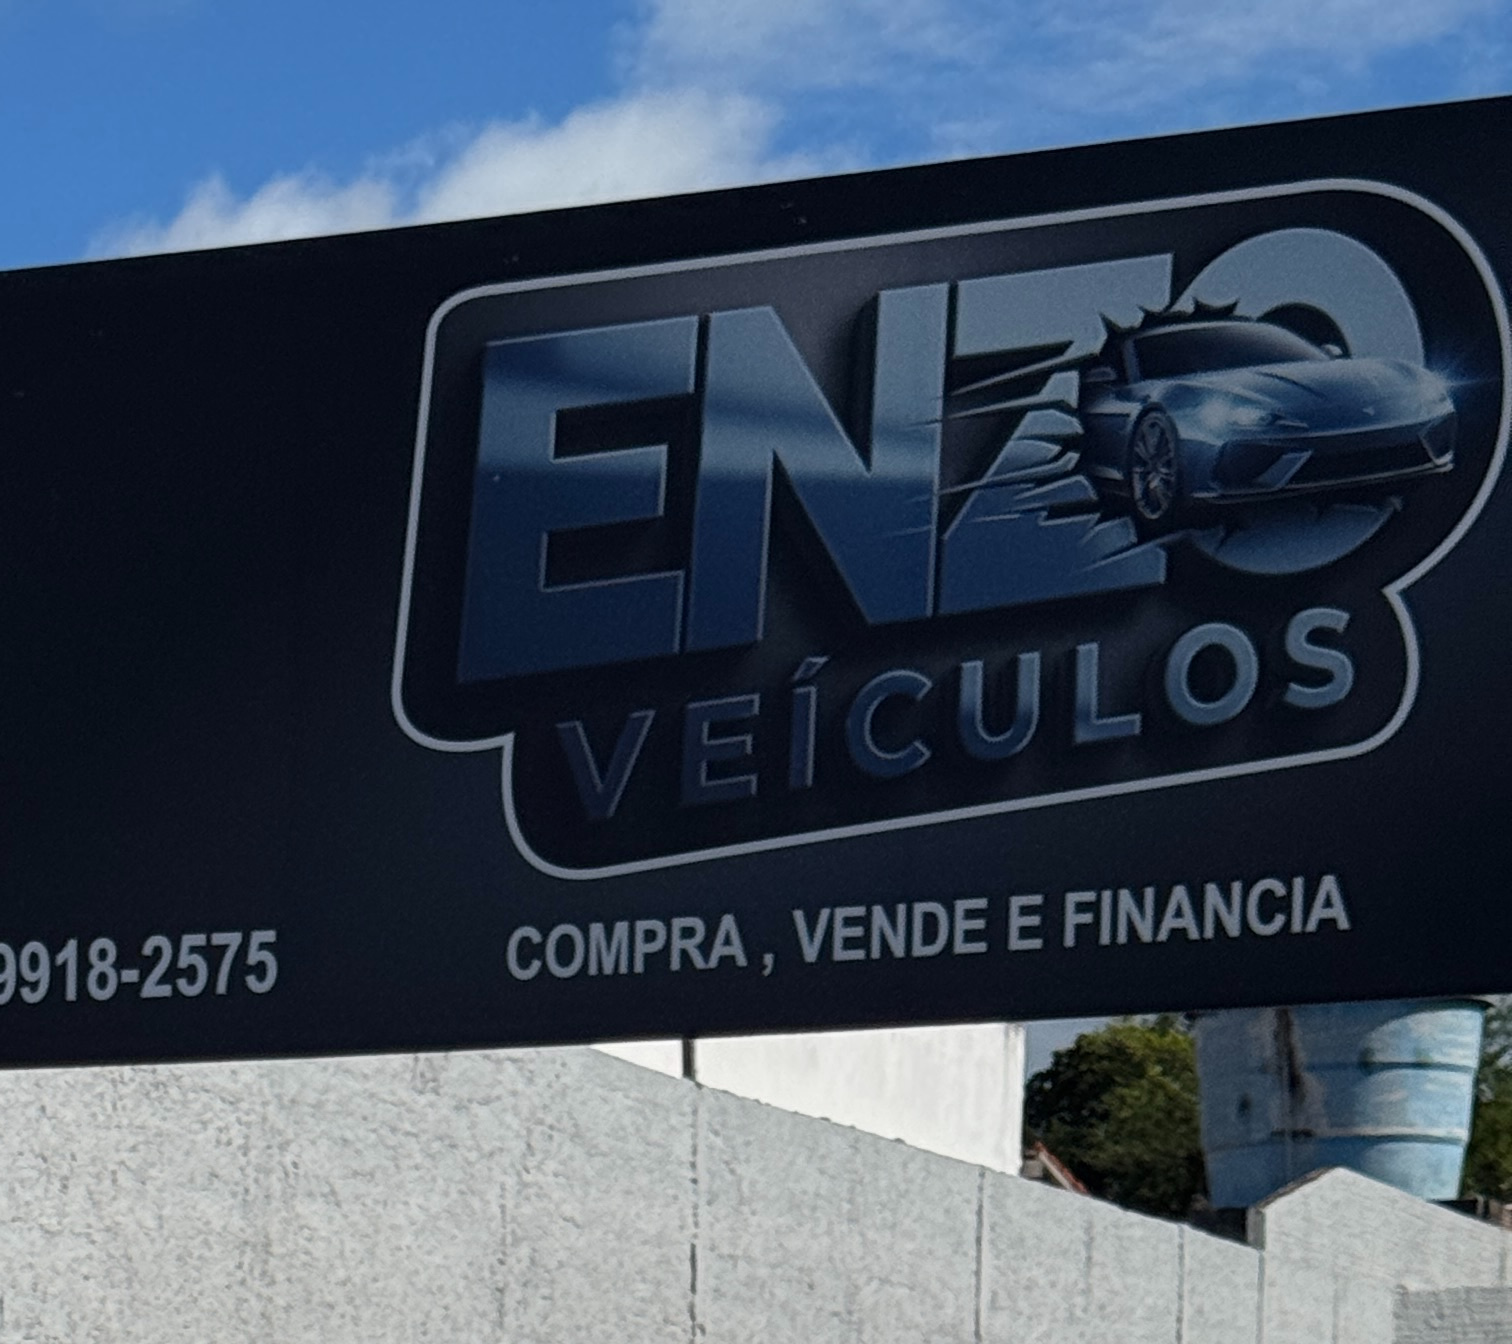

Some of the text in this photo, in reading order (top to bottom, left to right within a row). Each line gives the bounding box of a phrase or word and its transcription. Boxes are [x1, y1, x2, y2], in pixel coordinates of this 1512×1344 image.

[456, 226, 1424, 686] ENZO
[555, 607, 1356, 822] VEÍCULOS
[792, 896, 989, 964] VENDE
[1007, 893, 1044, 952] E
[1062, 875, 1352, 948] FINANCIA
